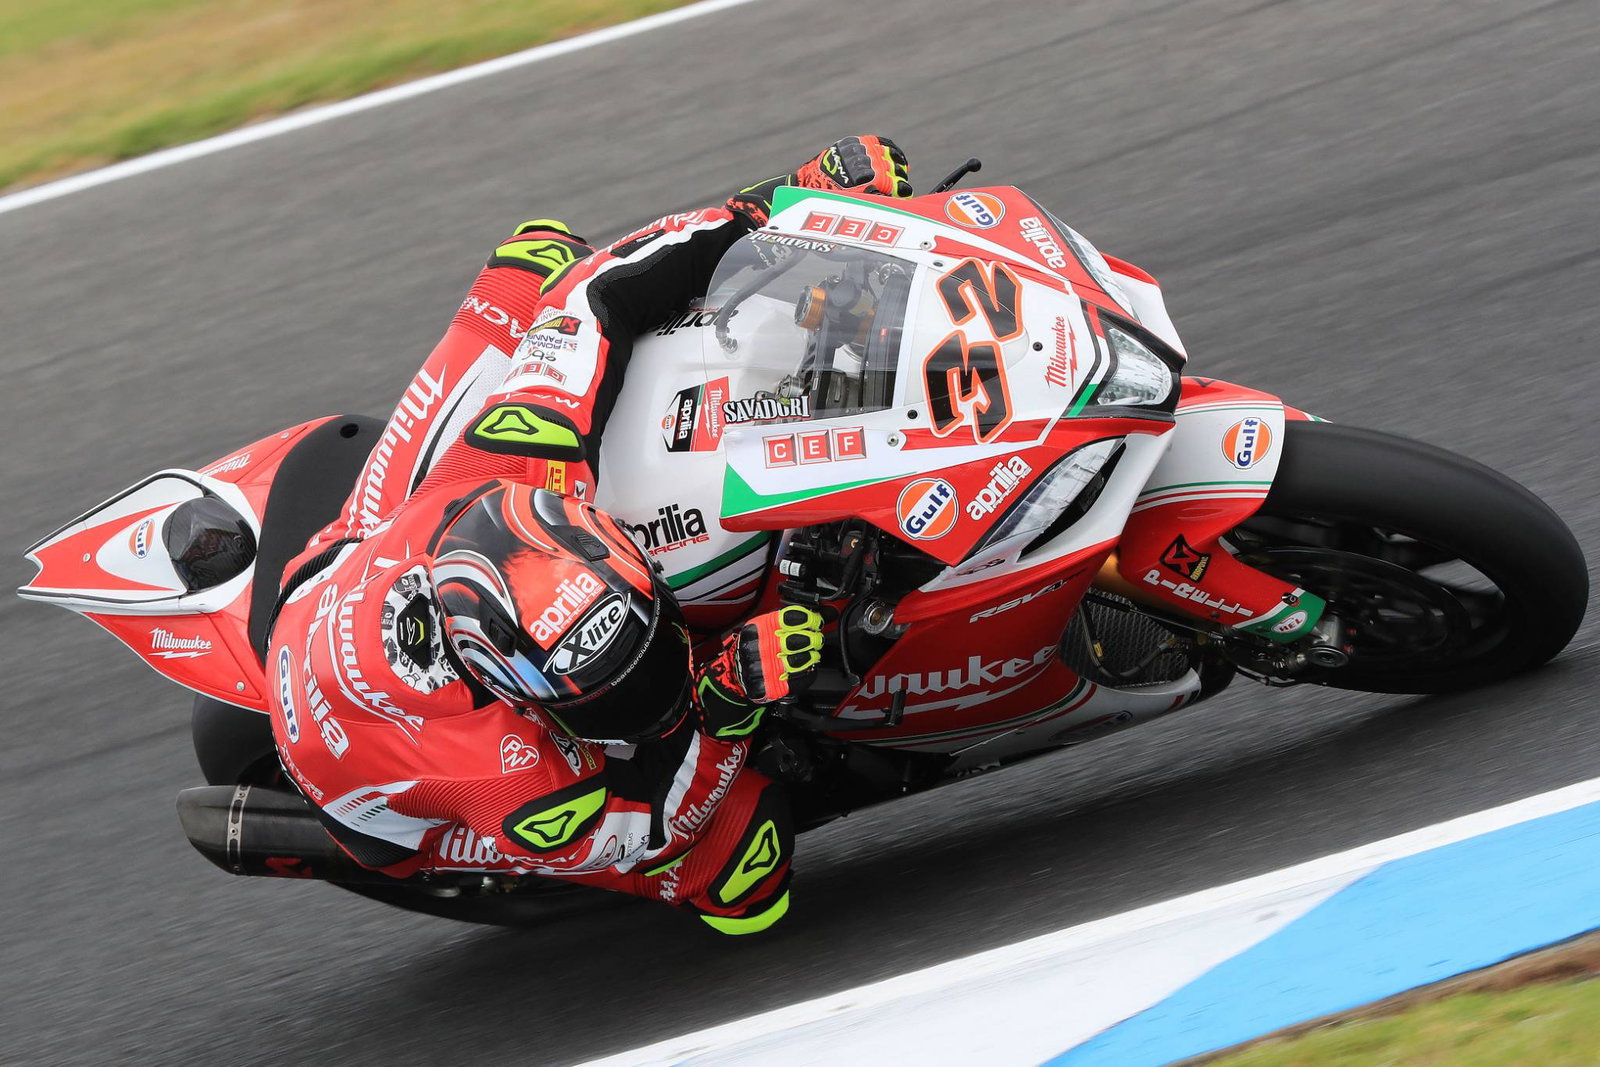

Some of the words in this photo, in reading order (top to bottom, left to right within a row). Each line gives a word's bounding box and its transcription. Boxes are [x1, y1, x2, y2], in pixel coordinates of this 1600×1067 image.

[808, 214, 897, 244] CEF
[956, 192, 994, 227] Gulf
[1019, 216, 1067, 269] aprilia
[922, 257, 1024, 444] 32
[1043, 316, 1067, 390] Milwaukee
[678, 398, 694, 440] aprilia
[709, 385, 723, 439] Milwaukee
[723, 395, 811, 423] SAVADORI
[358, 363, 447, 538] Milwauke
[769, 432, 859, 462] CEF
[1237, 419, 1258, 467] Gulf
[905, 483, 951, 535] Gulf
[966, 455, 1030, 520] aprilia
[136, 520, 150, 557] Gulf
[529, 571, 599, 642] aprilia
[1143, 569, 1254, 616] PIRELLI
[149, 627, 212, 650] Milwaukee
[561, 609, 622, 671] X-lite
[279, 649, 299, 737] Gulf
[669, 744, 743, 840] Milwaukee
